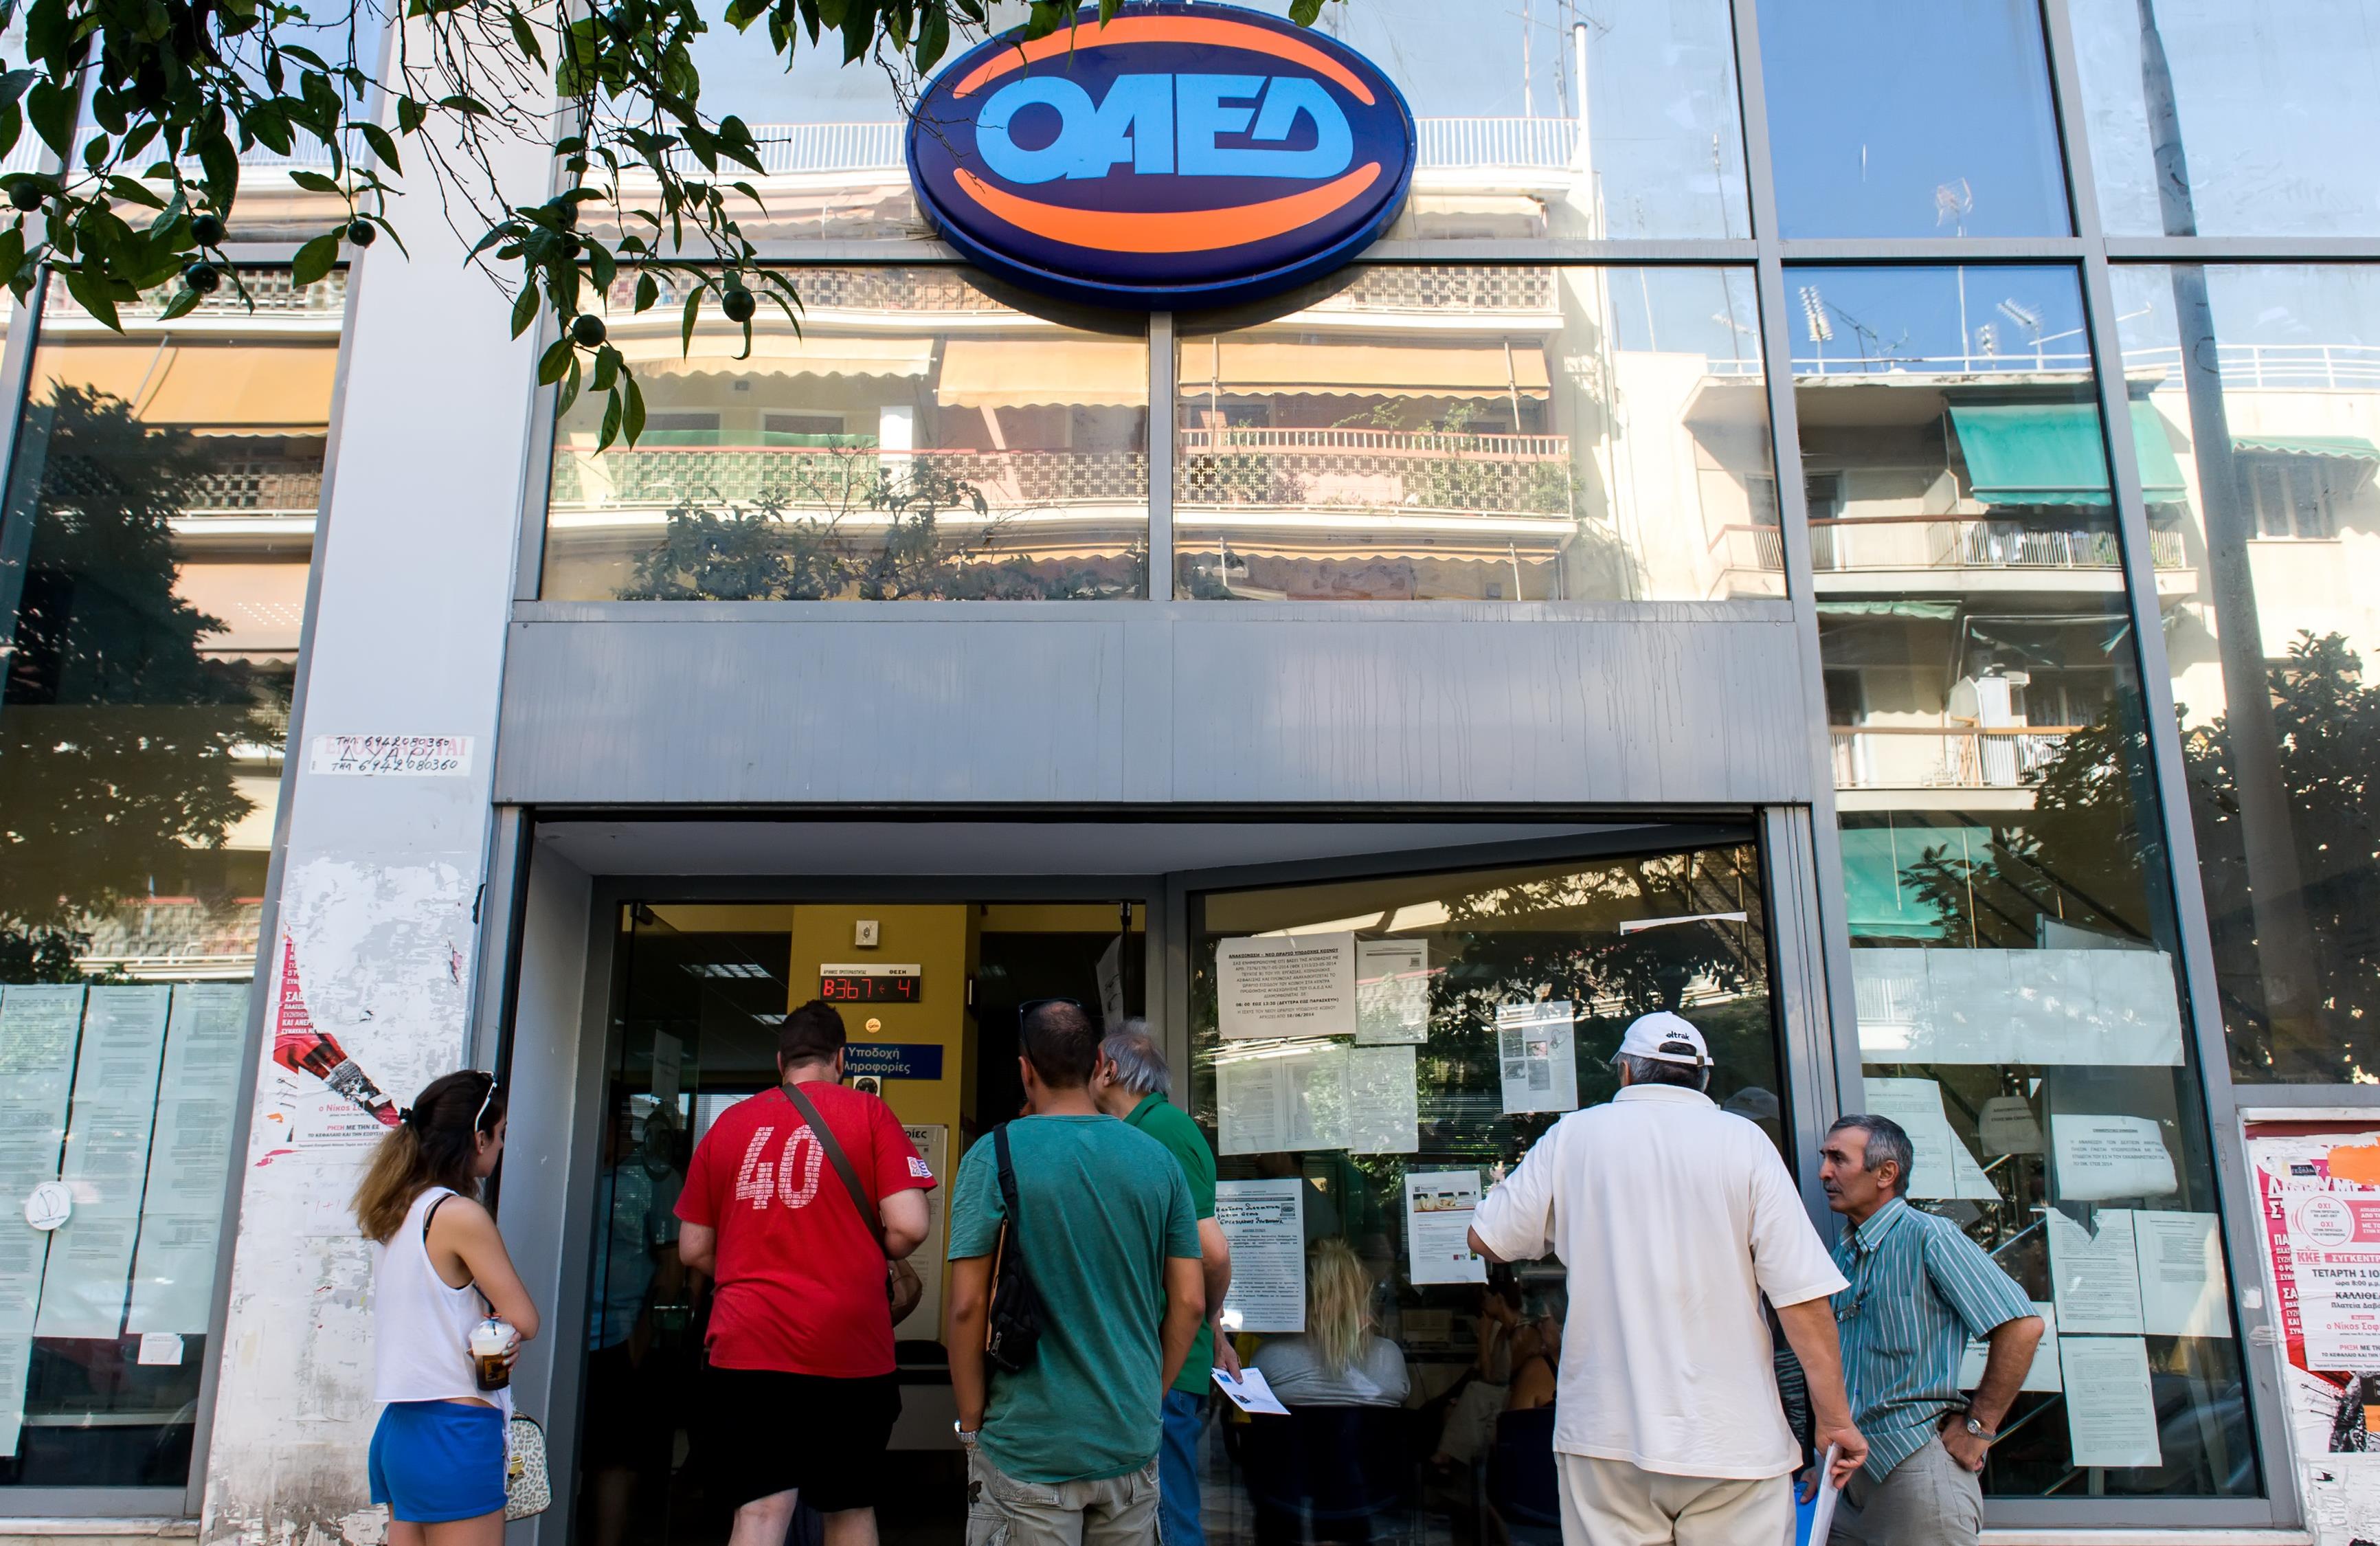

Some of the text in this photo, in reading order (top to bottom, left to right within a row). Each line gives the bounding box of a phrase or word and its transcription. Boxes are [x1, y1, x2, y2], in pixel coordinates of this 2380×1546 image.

[898, 978, 910, 998] 4
[848, 1046, 900, 1060] Υποδοχή
[844, 1060, 911, 1075] ληροφορίες
[735, 1124, 824, 1210] 40
[2274, 1234, 2290, 1246] ΠΑ
[2297, 1252, 2320, 1262] ΚΚΕ
[2312, 1269, 2380, 1278] ΤΕΤΑΡΤΗ 1 ΙΟ
[2282, 1288, 2298, 1299] ΣΑ
[2287, 1318, 2300, 1326] ΚΑΙ
[2334, 1322, 2359, 1330] Νίκος
[2361, 1323, 2380, 1332] Σοφ
